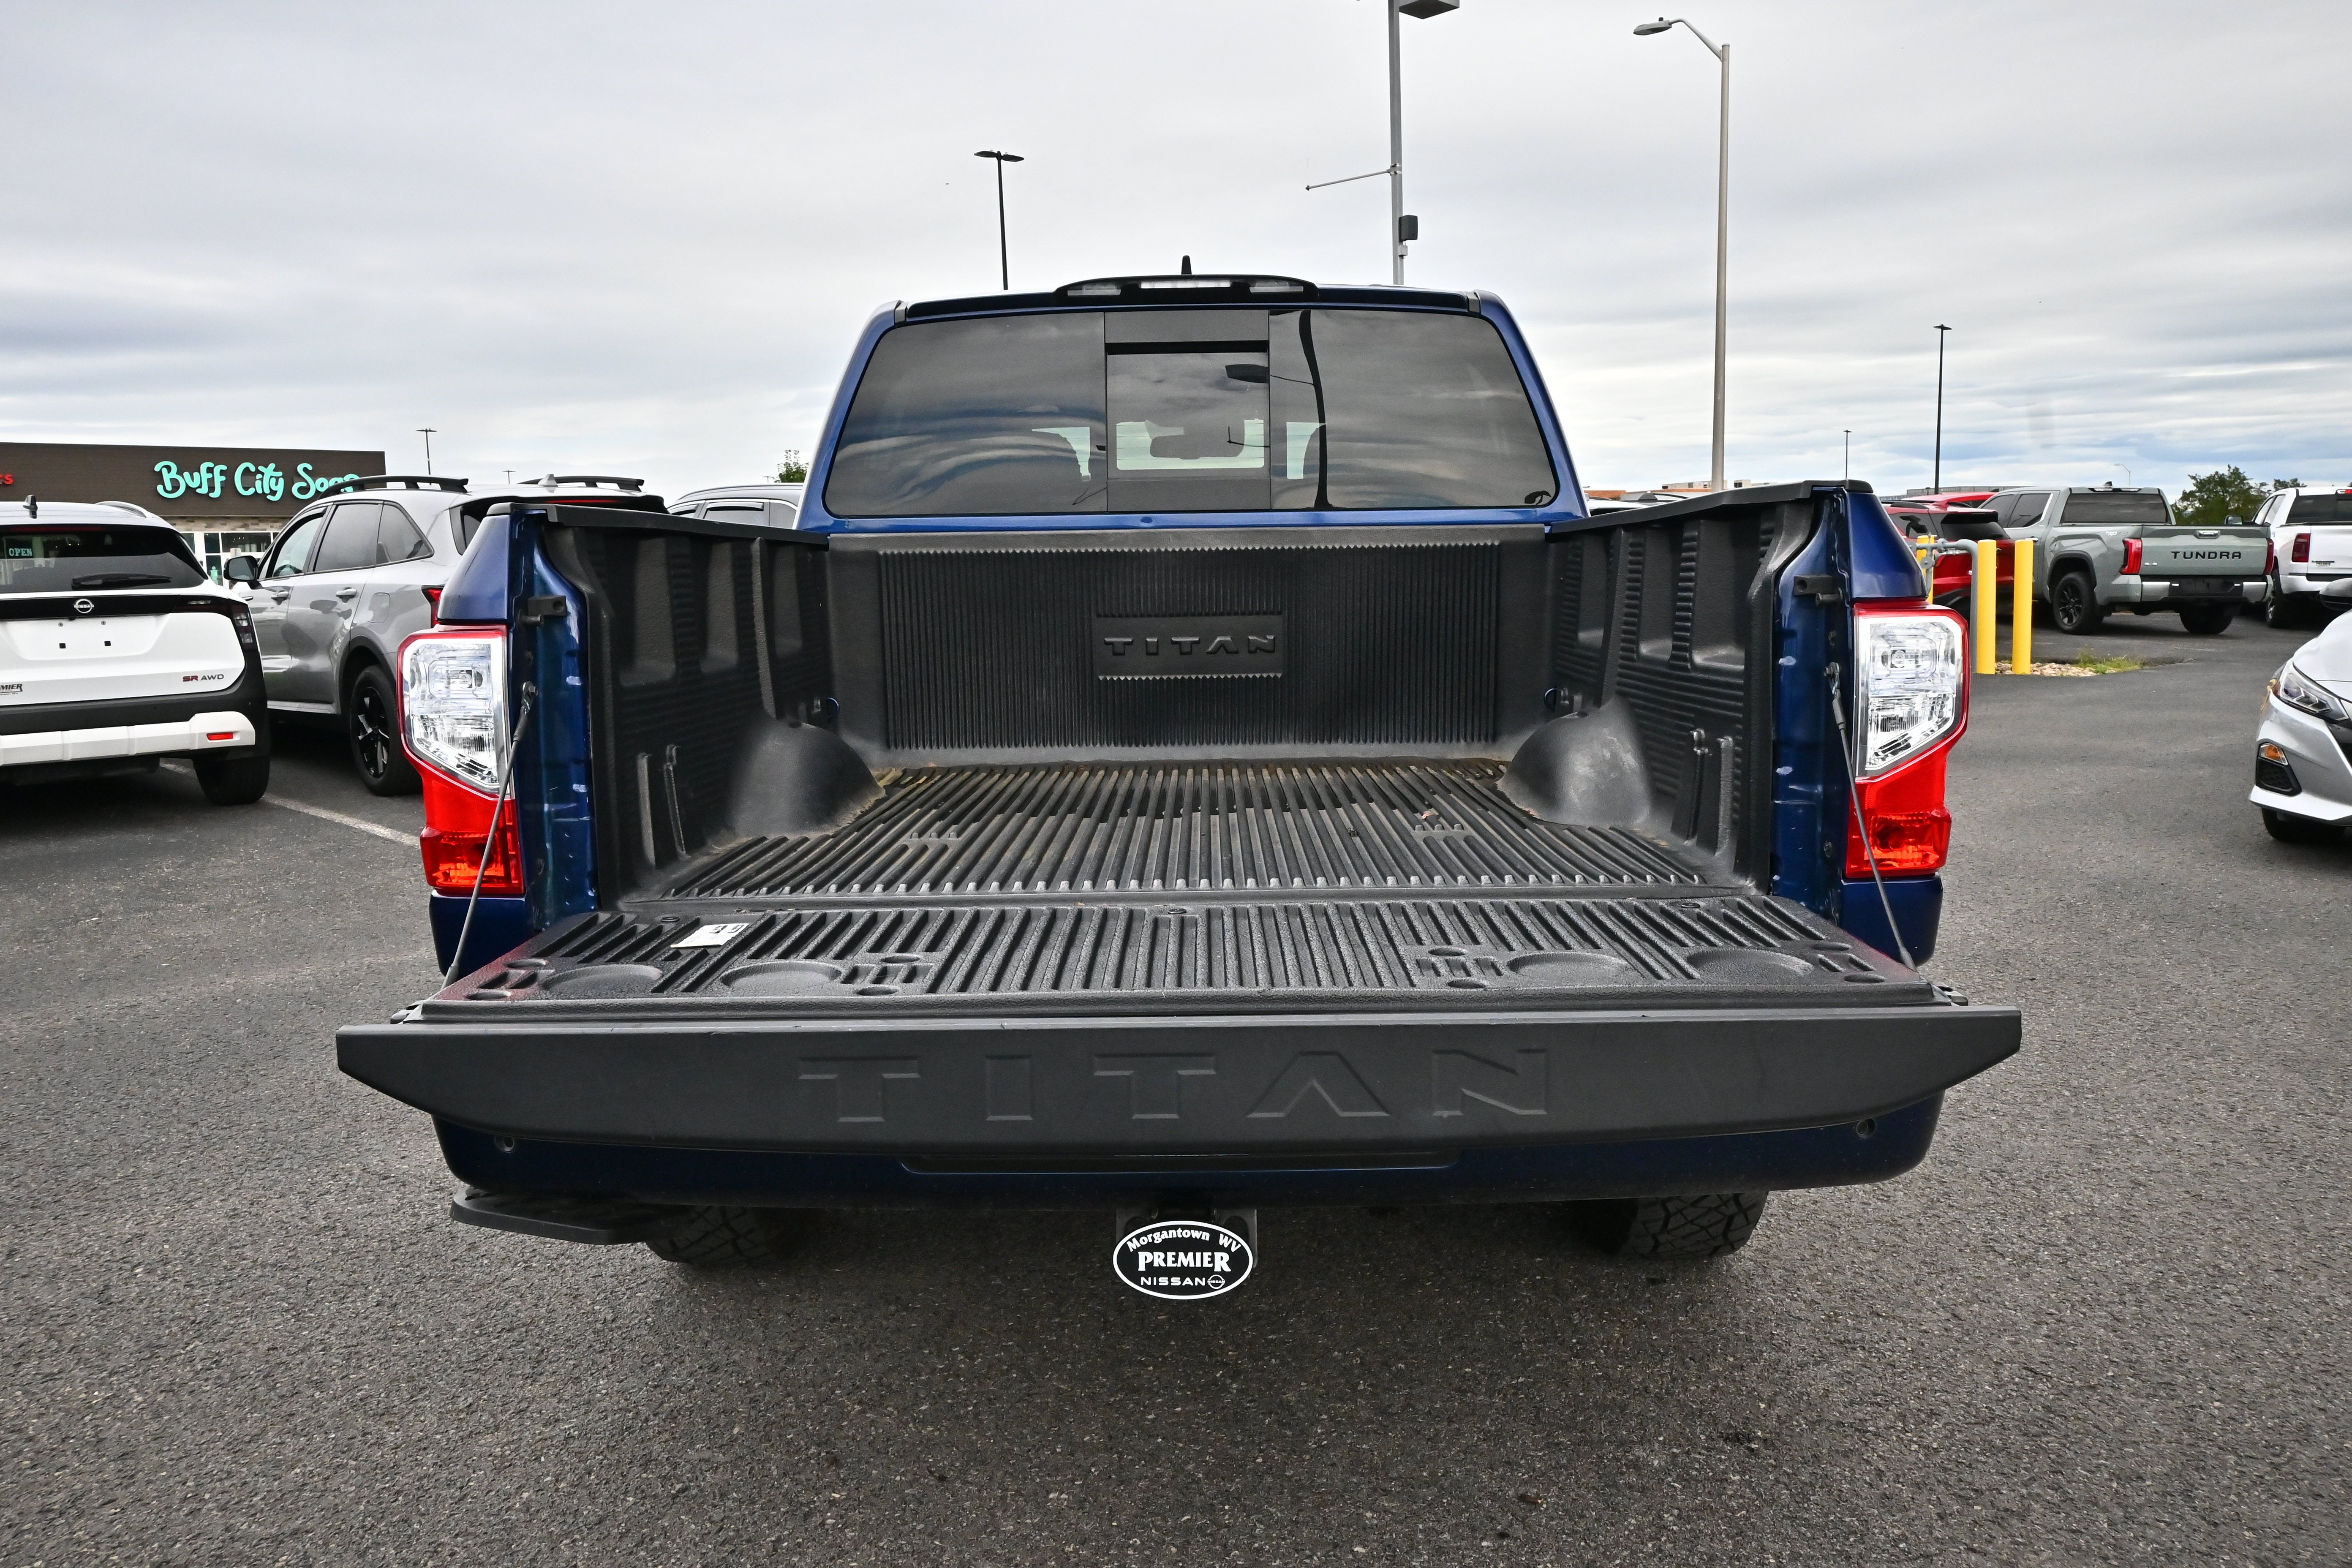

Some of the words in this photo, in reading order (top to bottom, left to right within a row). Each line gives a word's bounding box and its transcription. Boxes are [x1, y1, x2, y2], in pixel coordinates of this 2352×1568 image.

[154, 461, 227, 498] Buff
[234, 462, 284, 501] City
[8, 548, 33, 556] OPEN
[2171, 551, 2241, 559] TUNDRA
[1103, 634, 1275, 656] TITAN
[798, 1048, 1548, 1123] TITAN
[1126, 1227, 1210, 1252] Morgantown
[1219, 1233, 1241, 1252] WV
[1138, 1251, 1232, 1272] PREMIER
[1141, 1277, 1206, 1286] NISSAN
